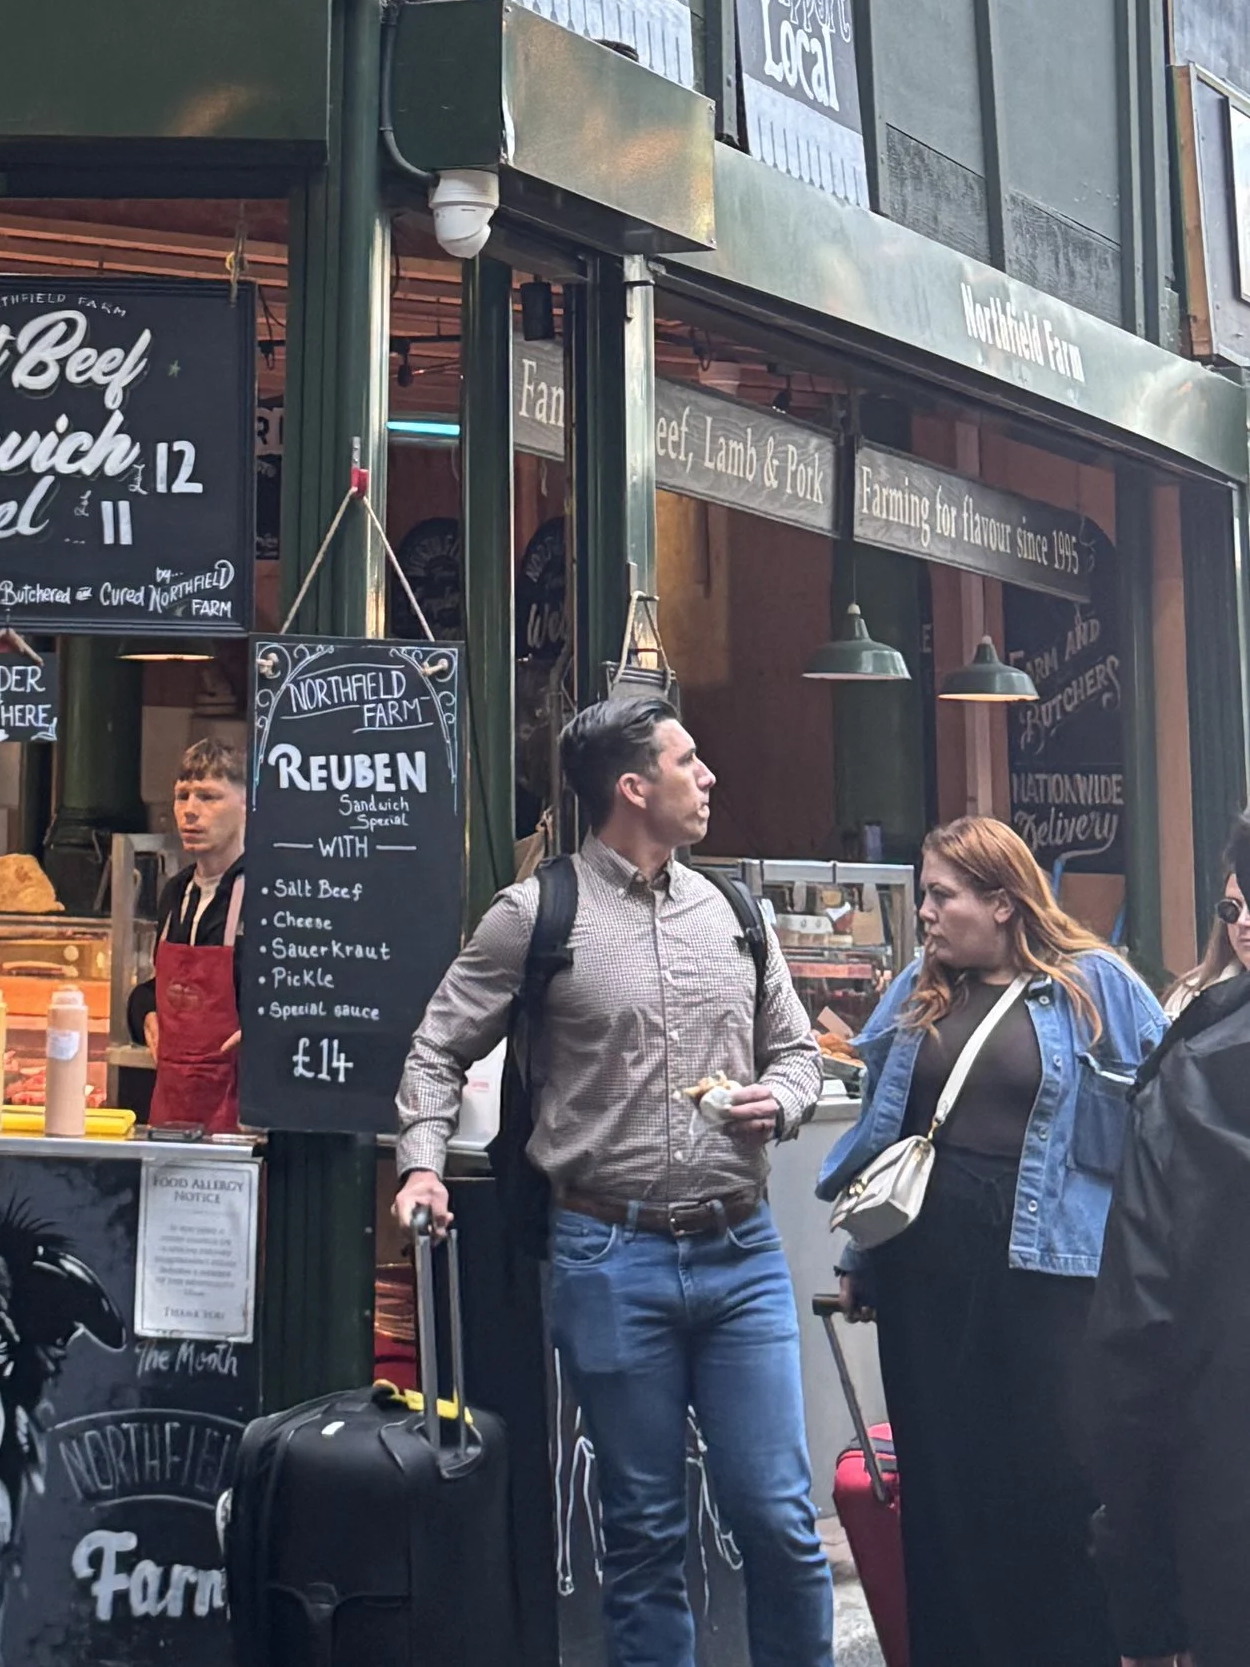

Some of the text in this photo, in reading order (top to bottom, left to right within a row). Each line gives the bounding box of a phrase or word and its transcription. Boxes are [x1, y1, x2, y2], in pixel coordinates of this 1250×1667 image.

[78, 297, 126, 318] FARM
[961, 282, 1086, 382] Northfield Farm
[12, 310, 151, 410] Beef
[156, 439, 204, 494] 12
[703, 415, 758, 483] Lamb
[763, 436, 780, 490] &
[786, 444, 823, 505] Pork
[861, 465, 1080, 575] Farming for flavour since 1995
[0, 580, 71, 605] Butchered
[100, 582, 145, 606] Cured
[192, 599, 232, 619] FARM
[285, 670, 406, 713] NORTHFIELD
[0, 703, 52, 727] HERE
[363, 698, 424, 728] FARM
[267, 743, 427, 793] REUBEN
[1012, 773, 1124, 805] NATIONWIDE
[339, 794, 410, 816] Sandwich
[356, 814, 409, 832] Special
[1014, 807, 1119, 854] Delivery
[318, 836, 369, 858] WITH
[273, 879, 363, 901] Salt Beef
[273, 911, 333, 930] Cheese
[269, 1001, 379, 1021] Special sauce
[292, 1037, 354, 1083] £14
[134, 1337, 238, 1378] The Month
